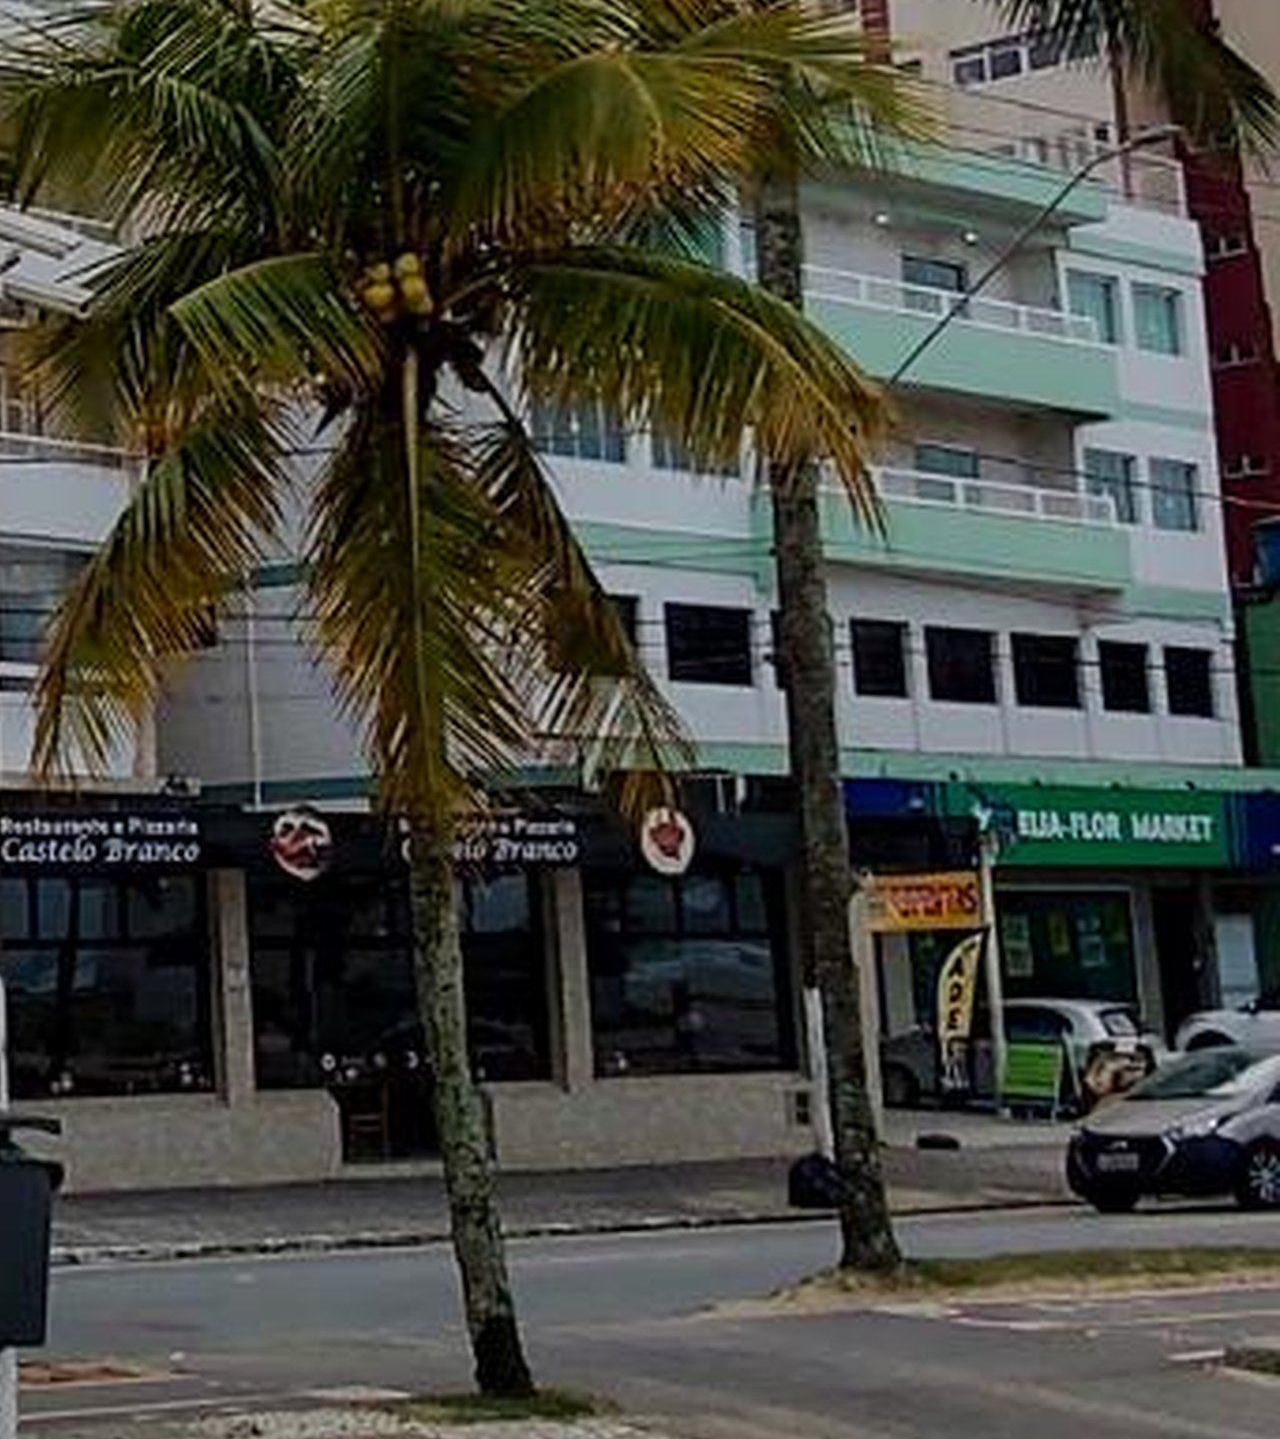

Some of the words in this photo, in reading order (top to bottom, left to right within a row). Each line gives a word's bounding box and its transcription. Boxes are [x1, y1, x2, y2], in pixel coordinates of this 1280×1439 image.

[0, 816, 109, 836] Restaurante
[128, 817, 199, 835] Pizzaria
[1131, 814, 1213, 841] MARKET
[0, 833, 98, 864] Castelo
[101, 837, 201, 863] Branco
[492, 837, 579, 863] Branco
